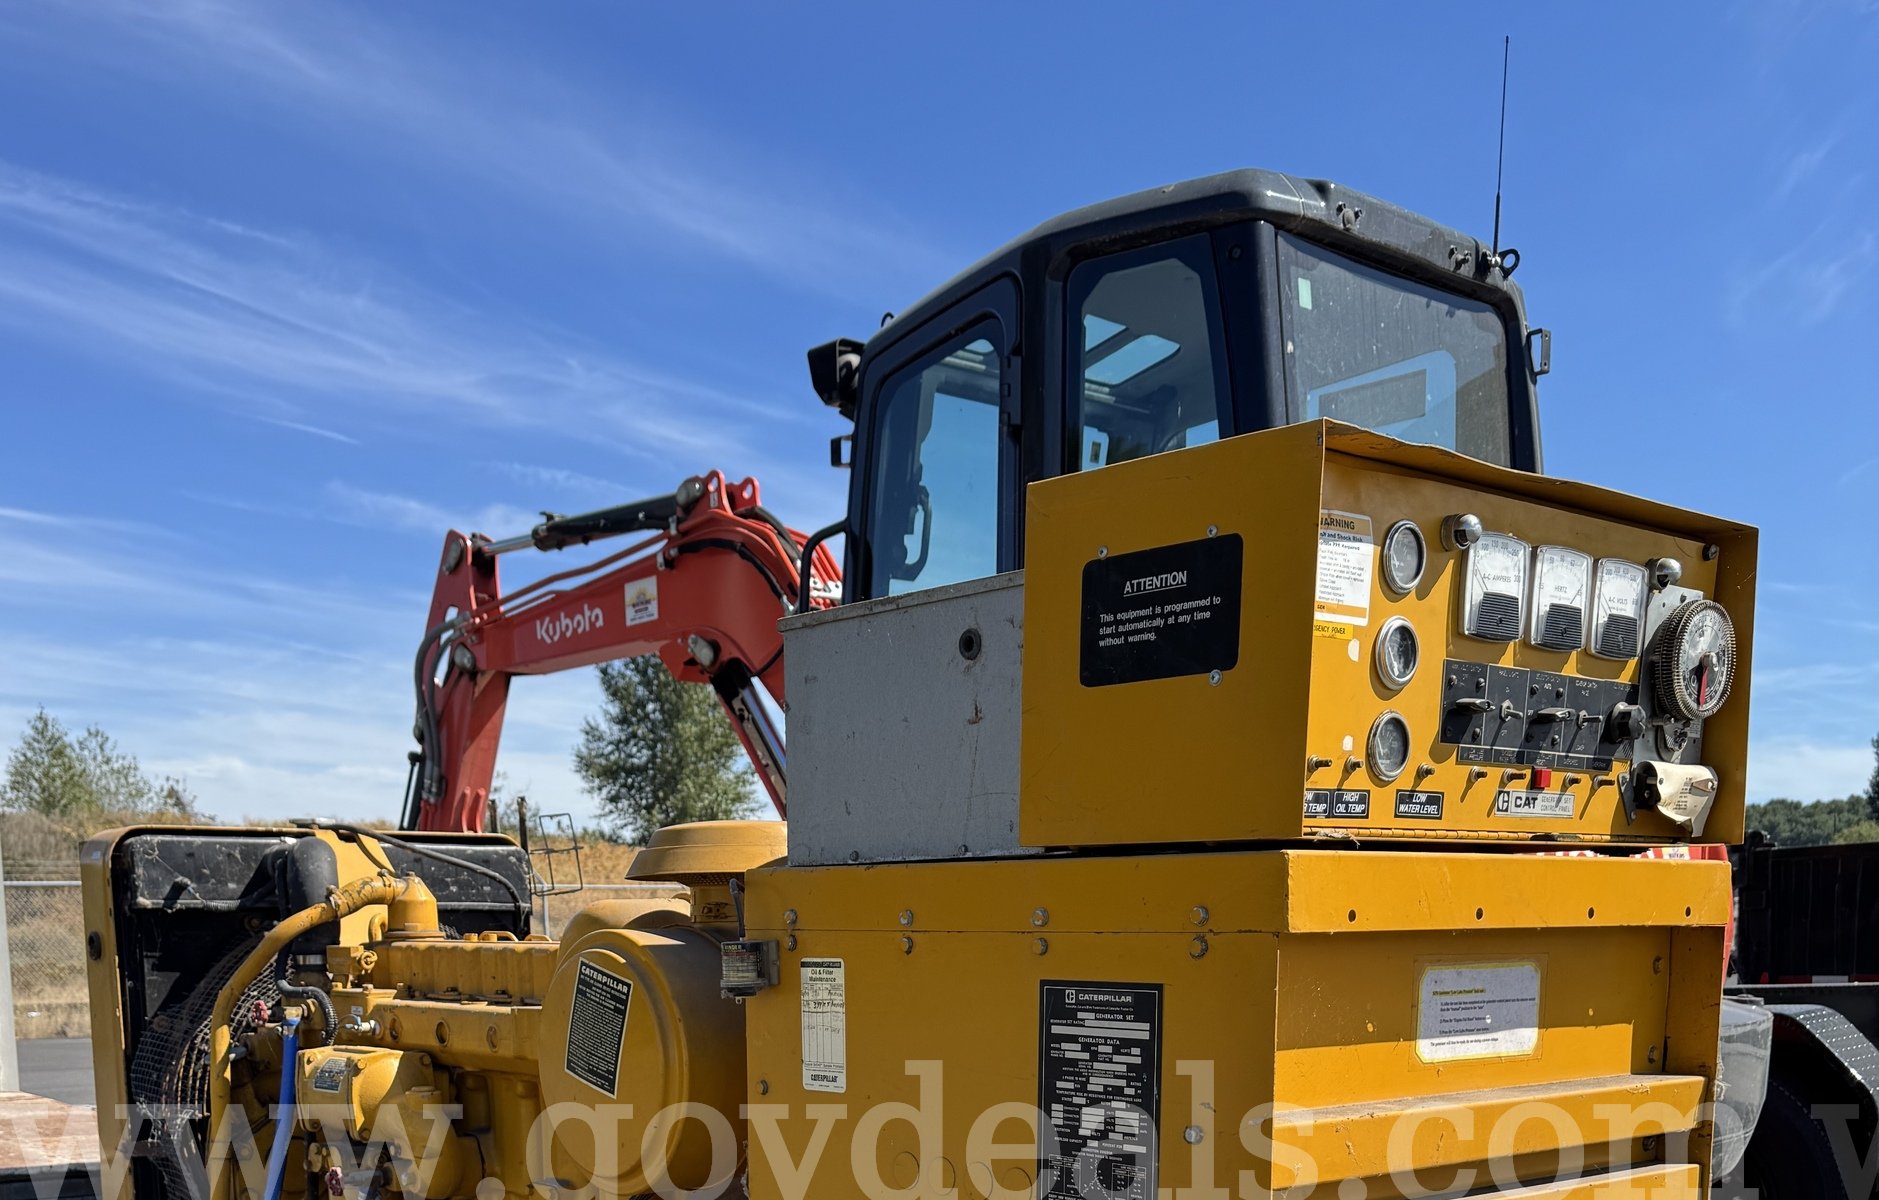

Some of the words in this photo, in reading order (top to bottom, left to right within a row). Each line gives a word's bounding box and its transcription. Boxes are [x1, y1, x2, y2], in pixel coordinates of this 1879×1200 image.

[1124, 570, 1187, 594] ATTENTION
[1554, 585, 1568, 593] HERTZ
[1100, 614, 1114, 623] This
[1117, 606, 1152, 620] equipment
[1155, 605, 1161, 614] is
[1164, 596, 1210, 613] programmed
[1213, 595, 1221, 605] to
[536, 603, 604, 644] Kubota
[1100, 626, 1116, 635] start
[1118, 617, 1164, 632] automatically
[1168, 616, 1175, 624] at
[1178, 613, 1191, 624] any
[1194, 610, 1210, 620] time
[1332, 626, 1346, 634] POWER
[1099, 635, 1124, 647] without
[1128, 632, 1156, 643] warning.
[1343, 793, 1359, 801] HIGH
[1412, 794, 1427, 802] LOW
[1308, 803, 1326, 812] TEMP
[1514, 796, 1538, 809] CAT
[1336, 804, 1347, 812] OIL
[1347, 804, 1366, 813] TEMP
[1399, 804, 1420, 813] WATER
[1420, 805, 1438, 814] LEVEL
[581, 966, 628, 994] CATERPILLAR
[1078, 993, 1132, 1002] CATERPILLAR
